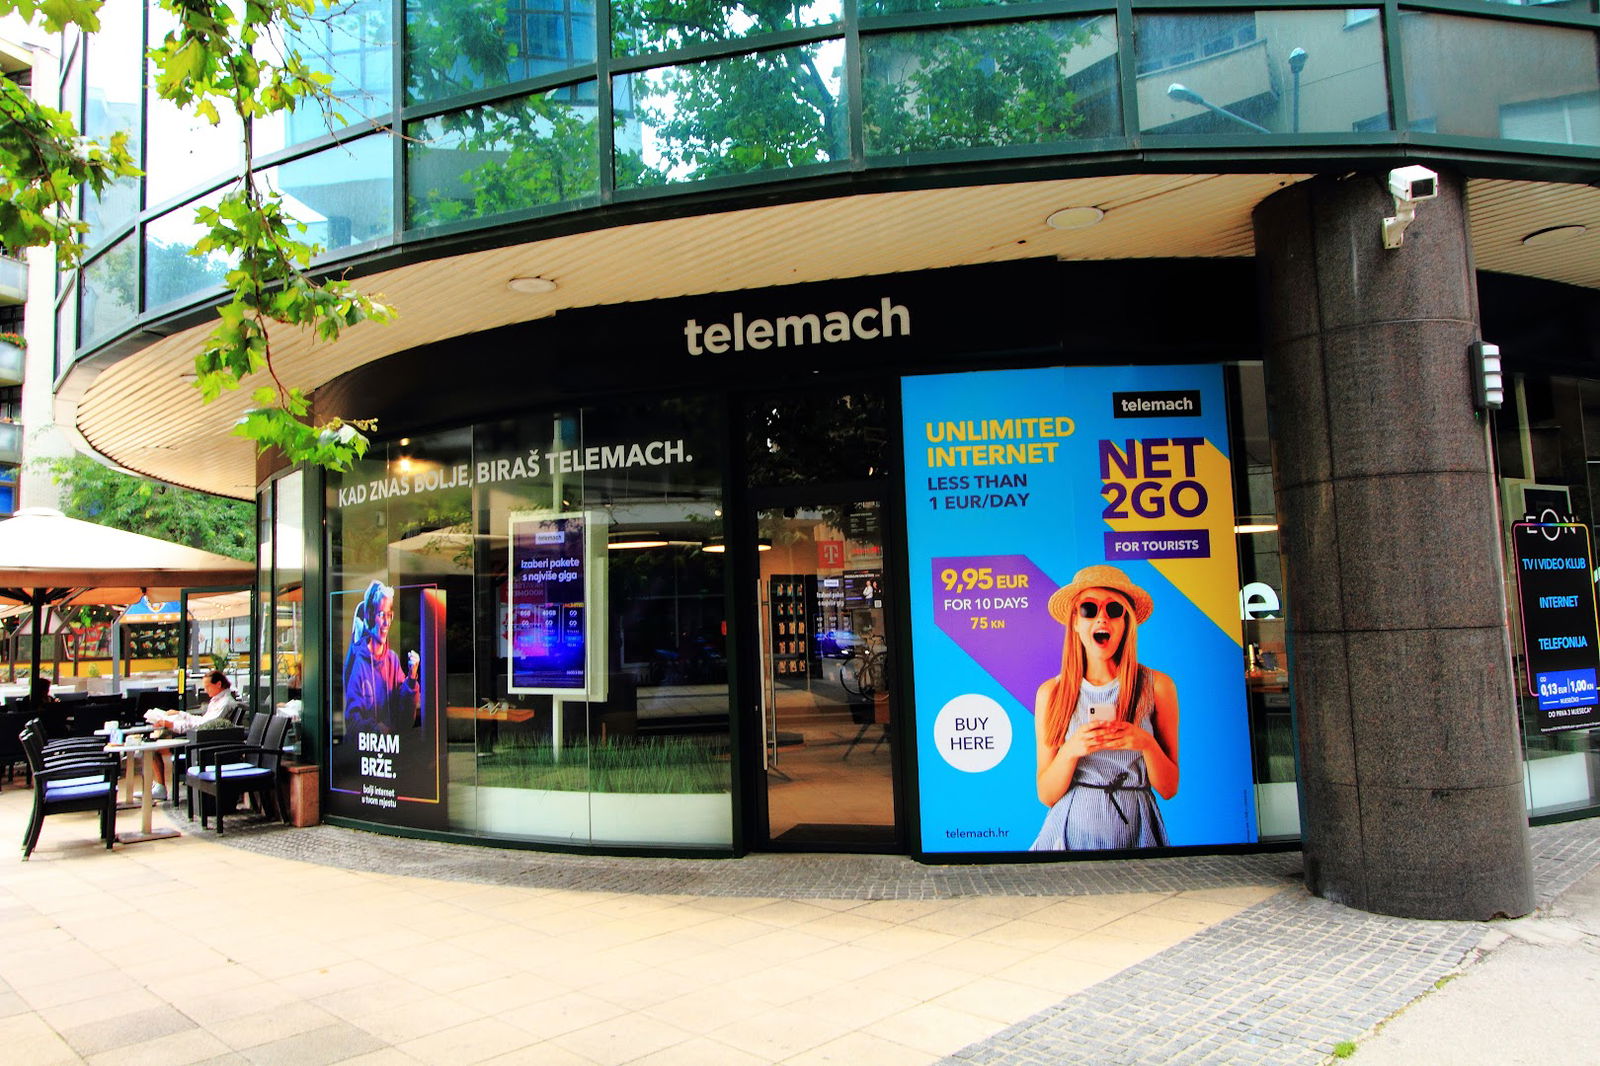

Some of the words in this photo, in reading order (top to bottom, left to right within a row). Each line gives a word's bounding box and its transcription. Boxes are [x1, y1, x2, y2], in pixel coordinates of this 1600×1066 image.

[684, 297, 911, 356] telemach
[1121, 397, 1193, 412] telemach
[925, 416, 1075, 443] UNLIMITED
[927, 442, 1059, 468] INTERNET
[1099, 436, 1205, 479] NET
[338, 484, 367, 507] KAD
[414, 464, 473, 493] BOLJE,
[477, 449, 540, 484] BIRAŠ
[545, 440, 693, 475] TELEMACH.
[928, 475, 969, 490] LESS
[974, 473, 1027, 489] THAN
[929, 496, 937, 510] 1
[945, 492, 1030, 510] EUR/DAY
[1100, 480, 1209, 519] 2GO
[1525, 508, 1576, 541] EON
[1115, 541, 1140, 552] FOR
[1141, 539, 1200, 551] TOURISTS
[521, 558, 548, 569] Izaberi
[549, 557, 580, 569] pakete
[1522, 558, 1534, 570] TV
[1534, 558, 1538, 570] I
[1538, 558, 1565, 570] VIDEO
[1565, 557, 1586, 569] KLUB
[528, 570, 557, 583] najviše
[558, 570, 578, 582] giga
[941, 567, 994, 593] 9,95
[996, 574, 1029, 589] EUR
[944, 598, 971, 611] FOR
[975, 597, 991, 610] 10
[994, 596, 1029, 609] DAYS
[1539, 595, 1578, 608] INTERNET
[970, 617, 988, 629] 75
[991, 620, 1005, 629] KN
[1538, 635, 1588, 650] TELEFONIJA
[1540, 682, 1558, 696] 0,13
[1570, 679, 1587, 693] 1,00
[955, 717, 989, 731] BUY
[358, 732, 400, 754] BIRAM
[950, 736, 995, 750] HERE
[361, 753, 397, 779] BRŽE.
[362, 784, 374, 796] bolji
[374, 785, 395, 797] internet
[378, 797, 397, 809] mjestu
[945, 827, 1009, 839] telemach.hr
